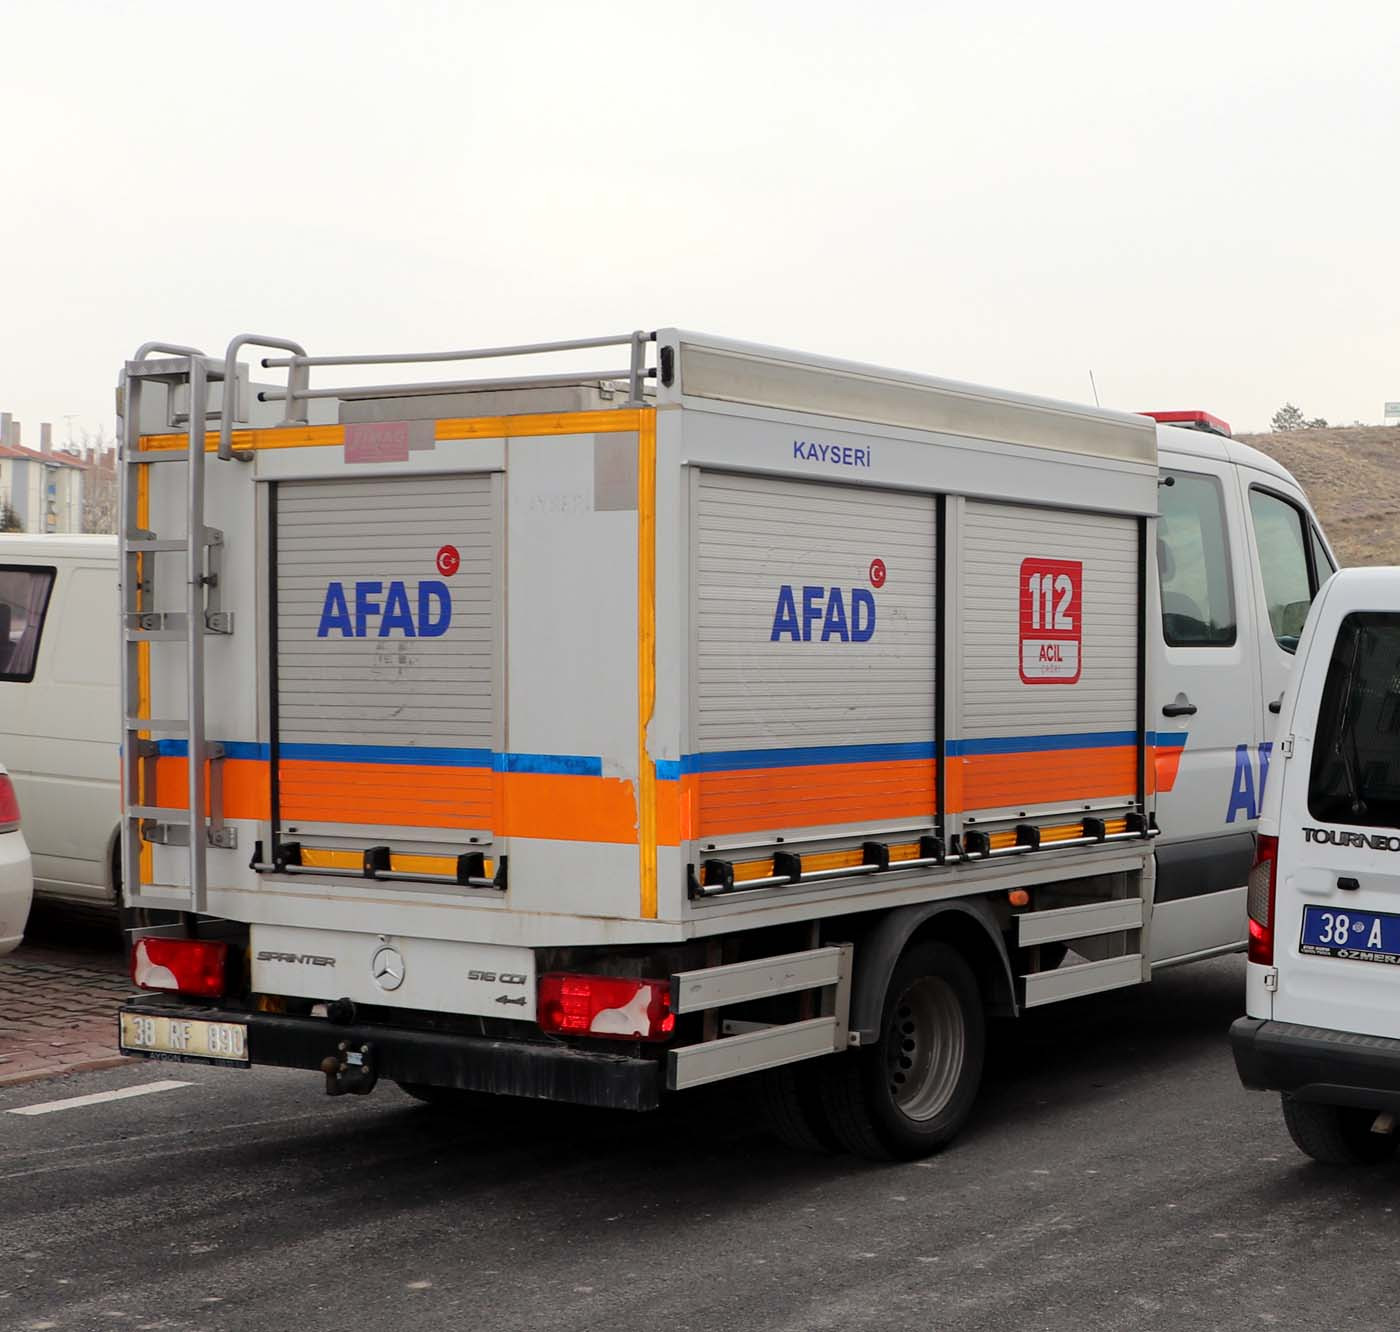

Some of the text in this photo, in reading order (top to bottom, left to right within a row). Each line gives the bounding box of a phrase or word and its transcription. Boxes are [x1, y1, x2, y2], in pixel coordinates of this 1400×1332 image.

[793, 440, 871, 467] KAYSERİ
[317, 580, 452, 638] AFAD
[770, 585, 876, 642] AFAD
[1028, 572, 1073, 630] 112
[1319, 913, 1350, 945] 38
[1367, 918, 1382, 949] A
[256, 951, 336, 968] SPRINTER
[468, 970, 497, 982] 516
[133, 1017, 245, 1056] 38 RF 890
